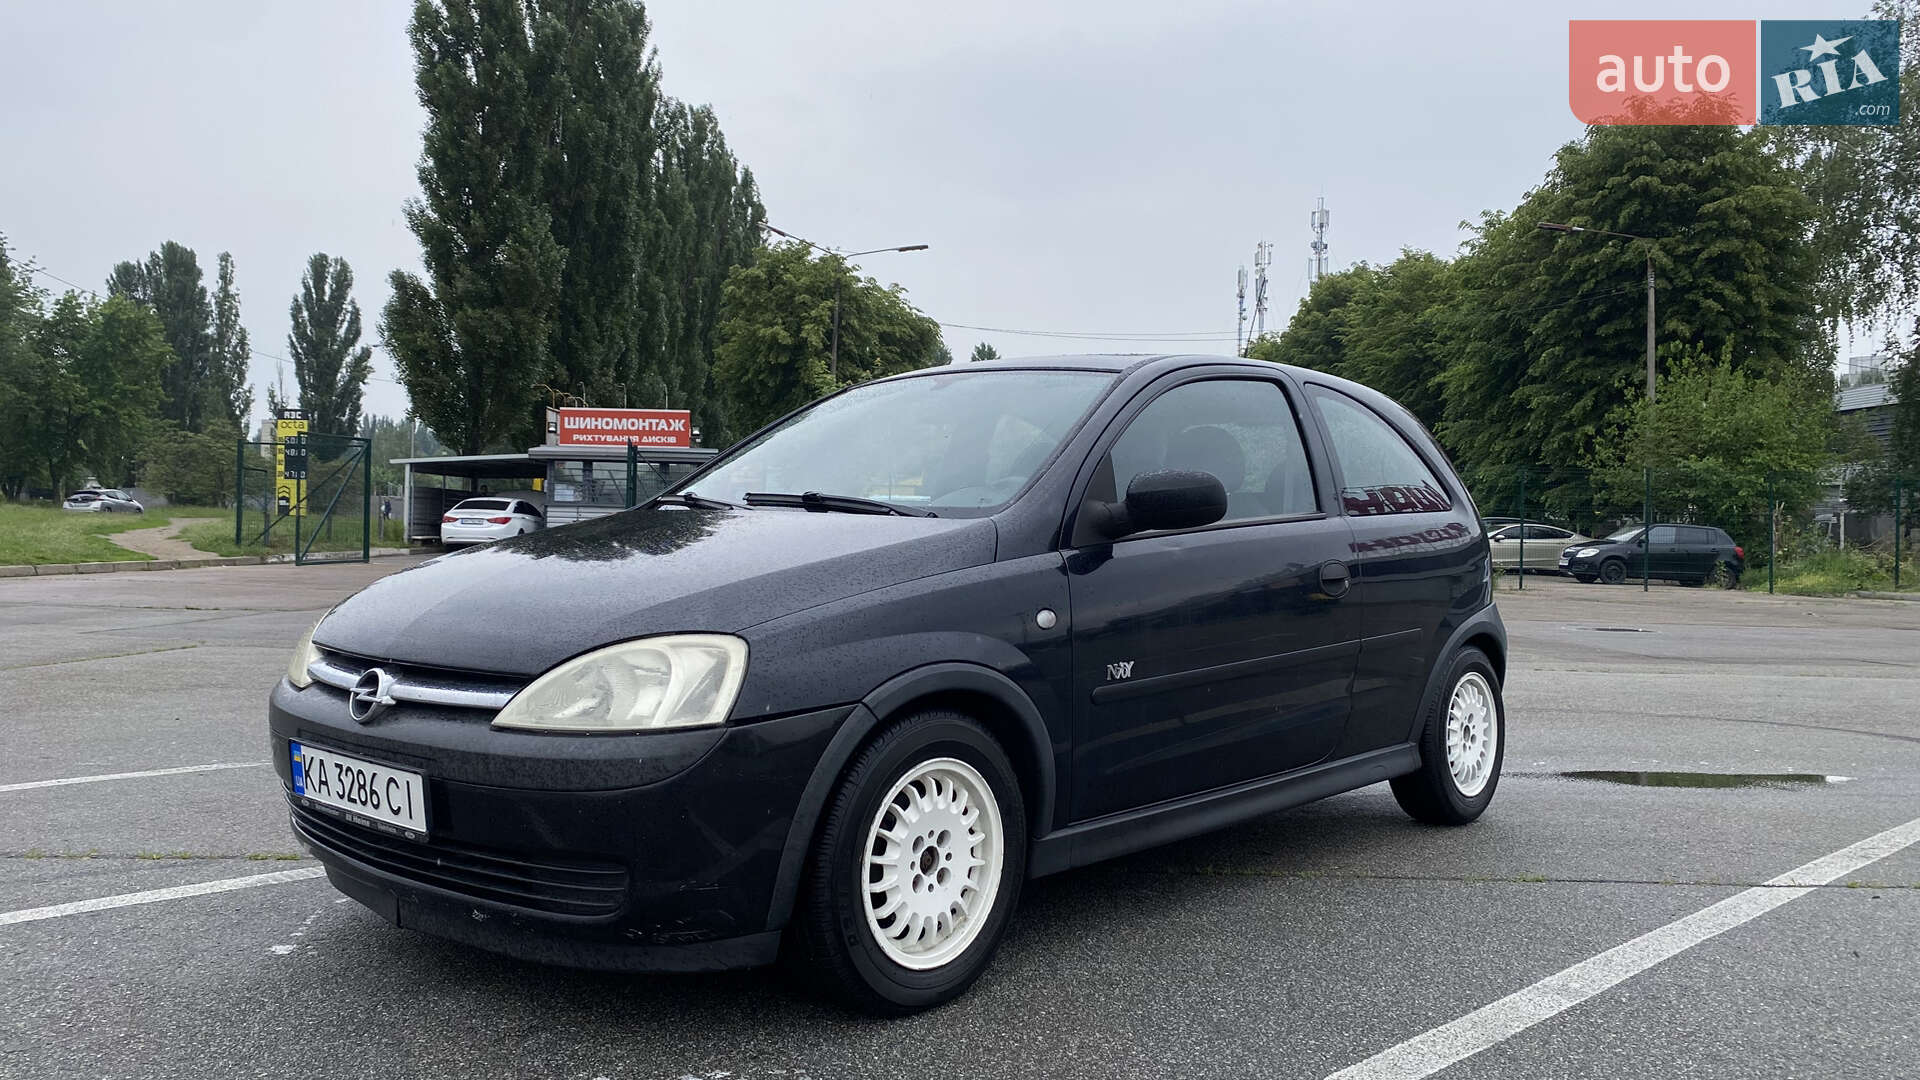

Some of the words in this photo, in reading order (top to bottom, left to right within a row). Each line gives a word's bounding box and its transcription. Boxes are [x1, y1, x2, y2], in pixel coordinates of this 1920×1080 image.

[563, 416, 686, 431] ШИНОМОНТАЖ
[641, 435, 677, 443] ДИСКІВ
[302, 754, 331, 797] KA
[334, 763, 380, 810] 3286
